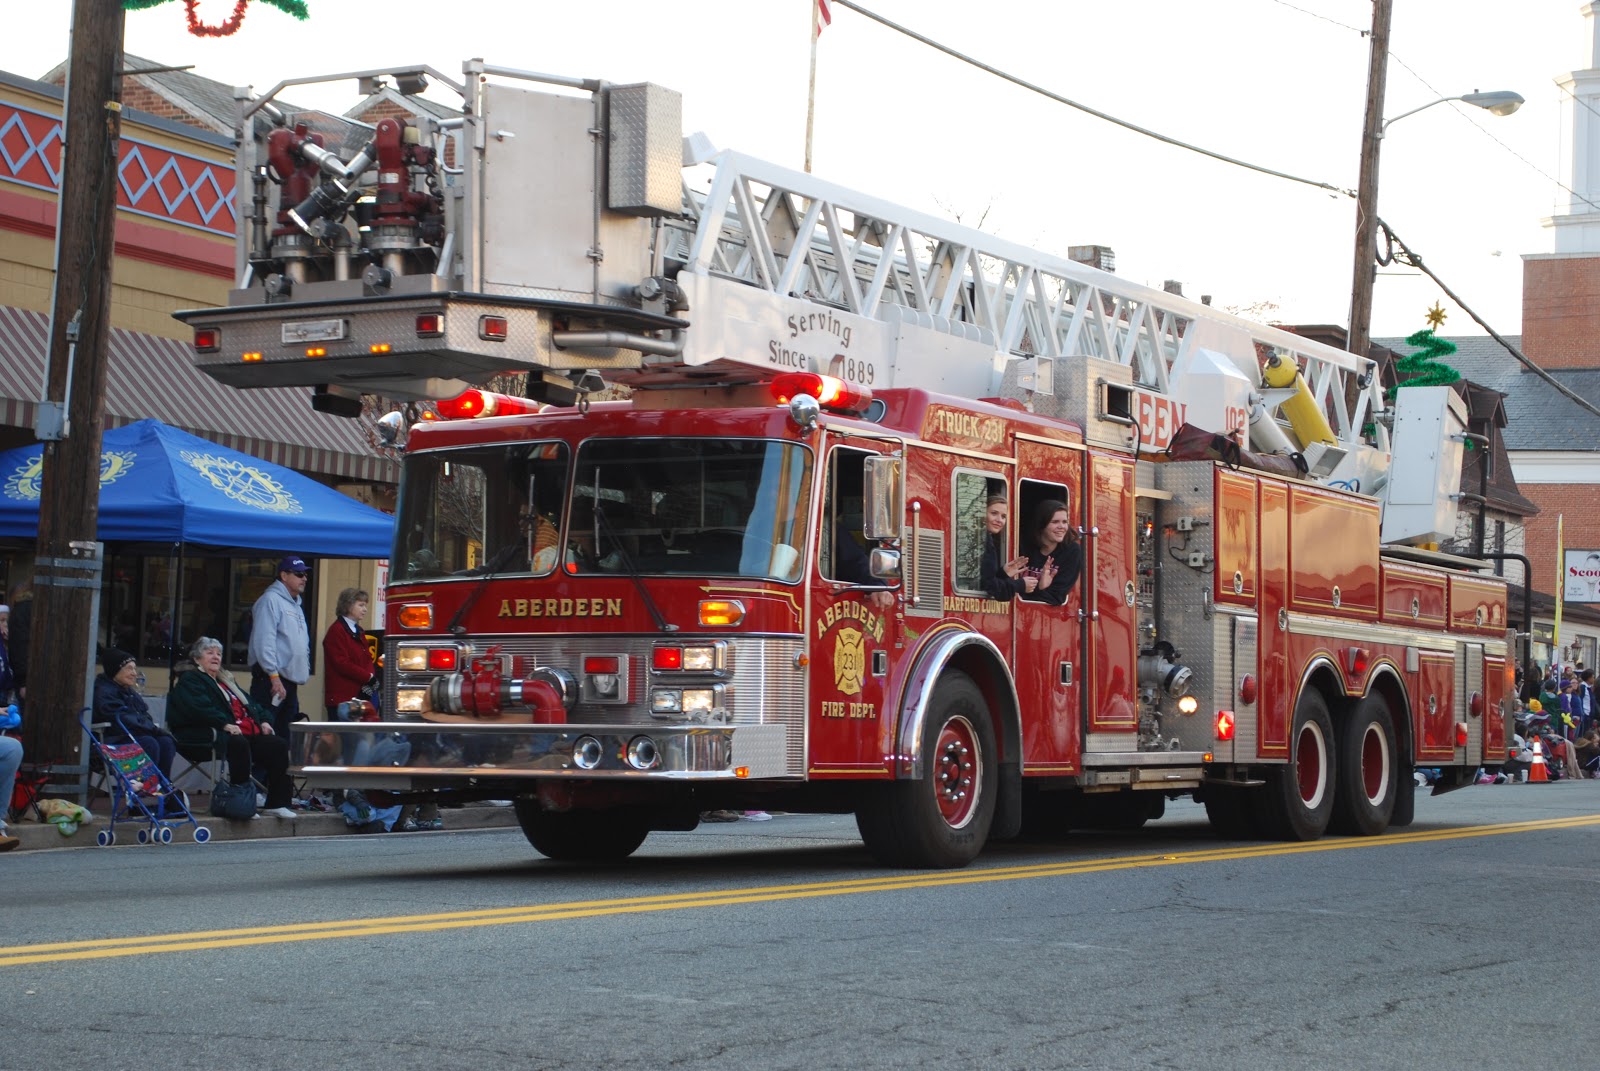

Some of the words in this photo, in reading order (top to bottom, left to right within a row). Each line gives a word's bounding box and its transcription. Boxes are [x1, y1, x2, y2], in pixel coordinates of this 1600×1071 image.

[788, 310, 852, 348] Serving
[769, 339, 806, 369] Since
[841, 357, 875, 385] 1889
[937, 409, 980, 438] TRUCK
[984, 420, 1004, 443] 231
[1132, 392, 1187, 448] EEN
[498, 598, 622, 617] ABERDEEN
[817, 600, 884, 643] ABERDEEN
[943, 595, 980, 613] HARFORD
[981, 599, 1010, 615] COUNTY
[843, 652, 857, 670] 231
[821, 701, 846, 717] FIRE
[850, 702, 876, 719] DEPT.
